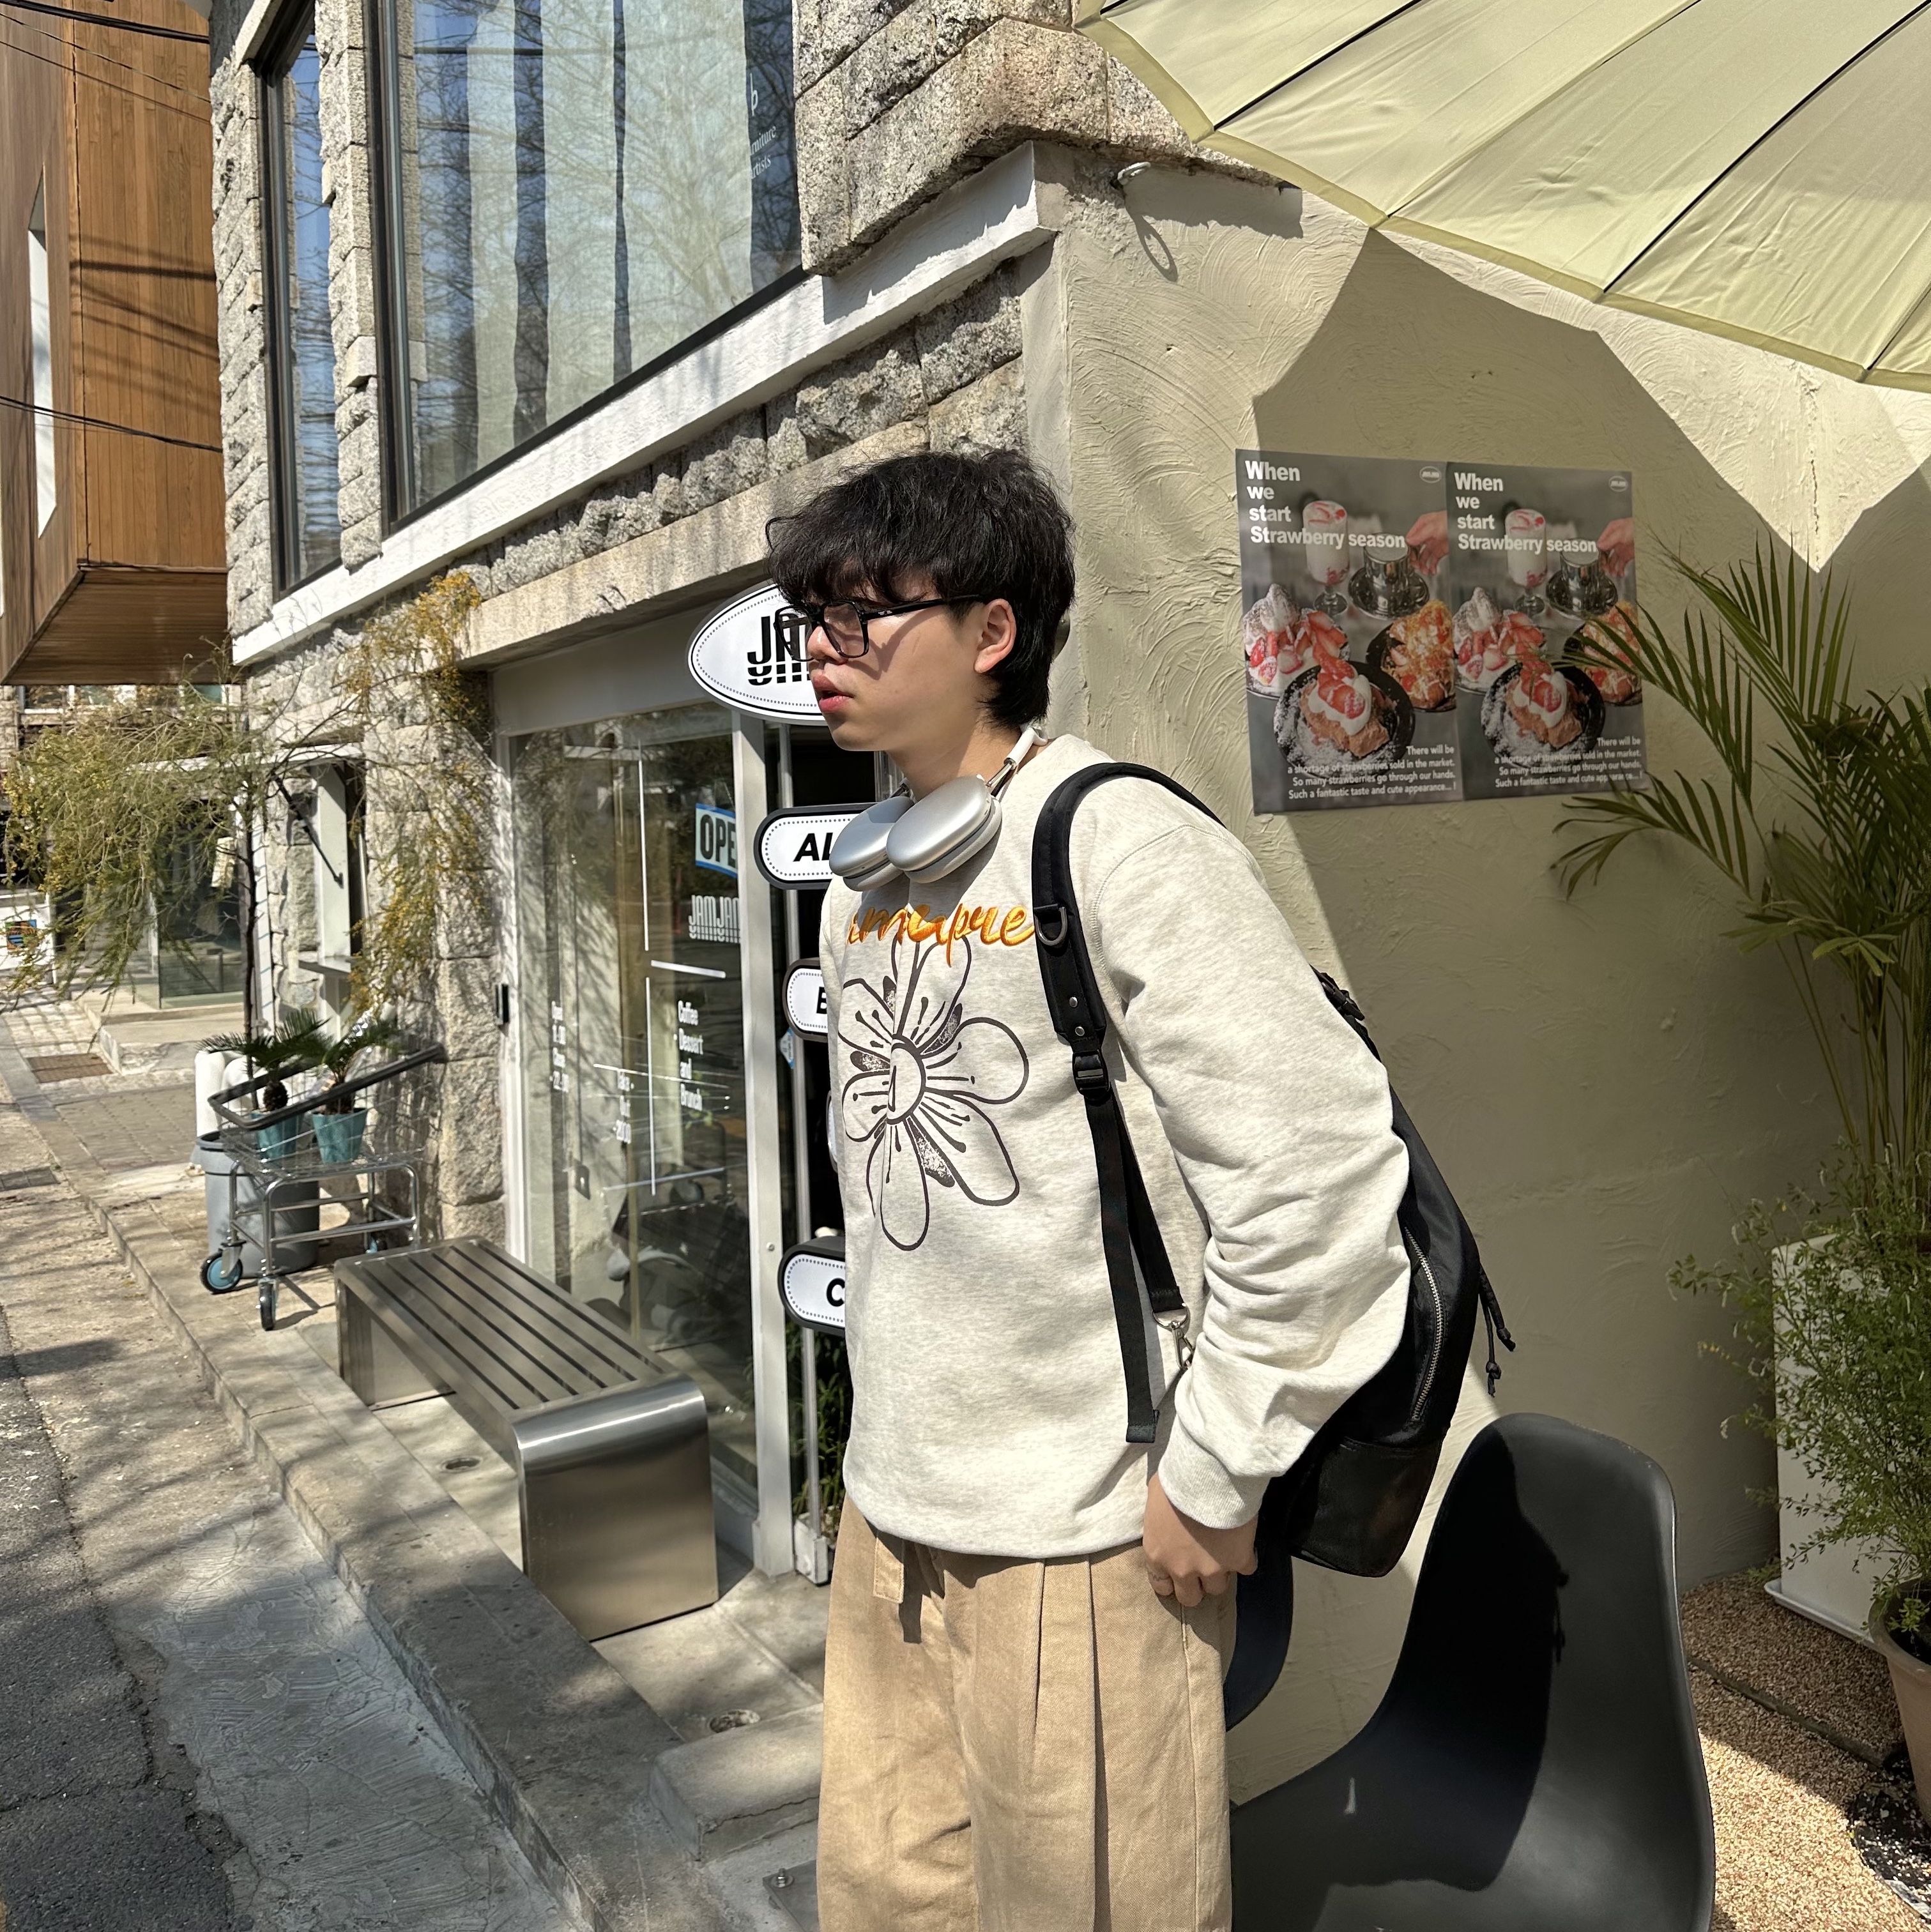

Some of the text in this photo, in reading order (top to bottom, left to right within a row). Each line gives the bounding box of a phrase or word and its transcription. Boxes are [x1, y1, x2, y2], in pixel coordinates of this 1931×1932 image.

[750, 126, 776, 156] rniture
[751, 155, 772, 179] rtists
[1245, 460, 1301, 482] When
[1454, 472, 1504, 492] When
[1246, 486, 1275, 499] we
[1455, 496, 1481, 509] we
[1249, 505, 1292, 522] start
[1457, 514, 1495, 529] start
[1250, 526, 1405, 550] Strawberry season
[1458, 533, 1597, 555] Strawberry season
[747, 613, 811, 686] JA
[1406, 744, 1454, 755] There will be
[1597, 736, 1641, 747] There will be
[1605, 749, 1615, 759] the
[1389, 759, 1405, 769] sold
[1407, 759, 1414, 768] in
[1415, 758, 1427, 768] the
[1499, 766, 1509, 775] So
[1510, 768, 1529, 777] many
[1572, 764, 1581, 774] go
[1582, 761, 1607, 773] through
[1293, 777, 1303, 786] So
[1305, 778, 1327, 787] many
[1377, 775, 1388, 784] go
[1389, 772, 1418, 783] through
[1495, 778, 1512, 787] Such
[1550, 776, 1566, 785] taste
[1567, 773, 1580, 783] and
[1581, 775, 1595, 783] cute
[1288, 788, 1308, 799] Such
[1316, 787, 1349, 798] fantastic
[1350, 787, 1370, 796] taste
[1371, 784, 1385, 795] and
[1387, 786, 1403, 794] cute
[700, 814, 737, 869] OPE
[678, 1028, 704, 1055] Dessert
